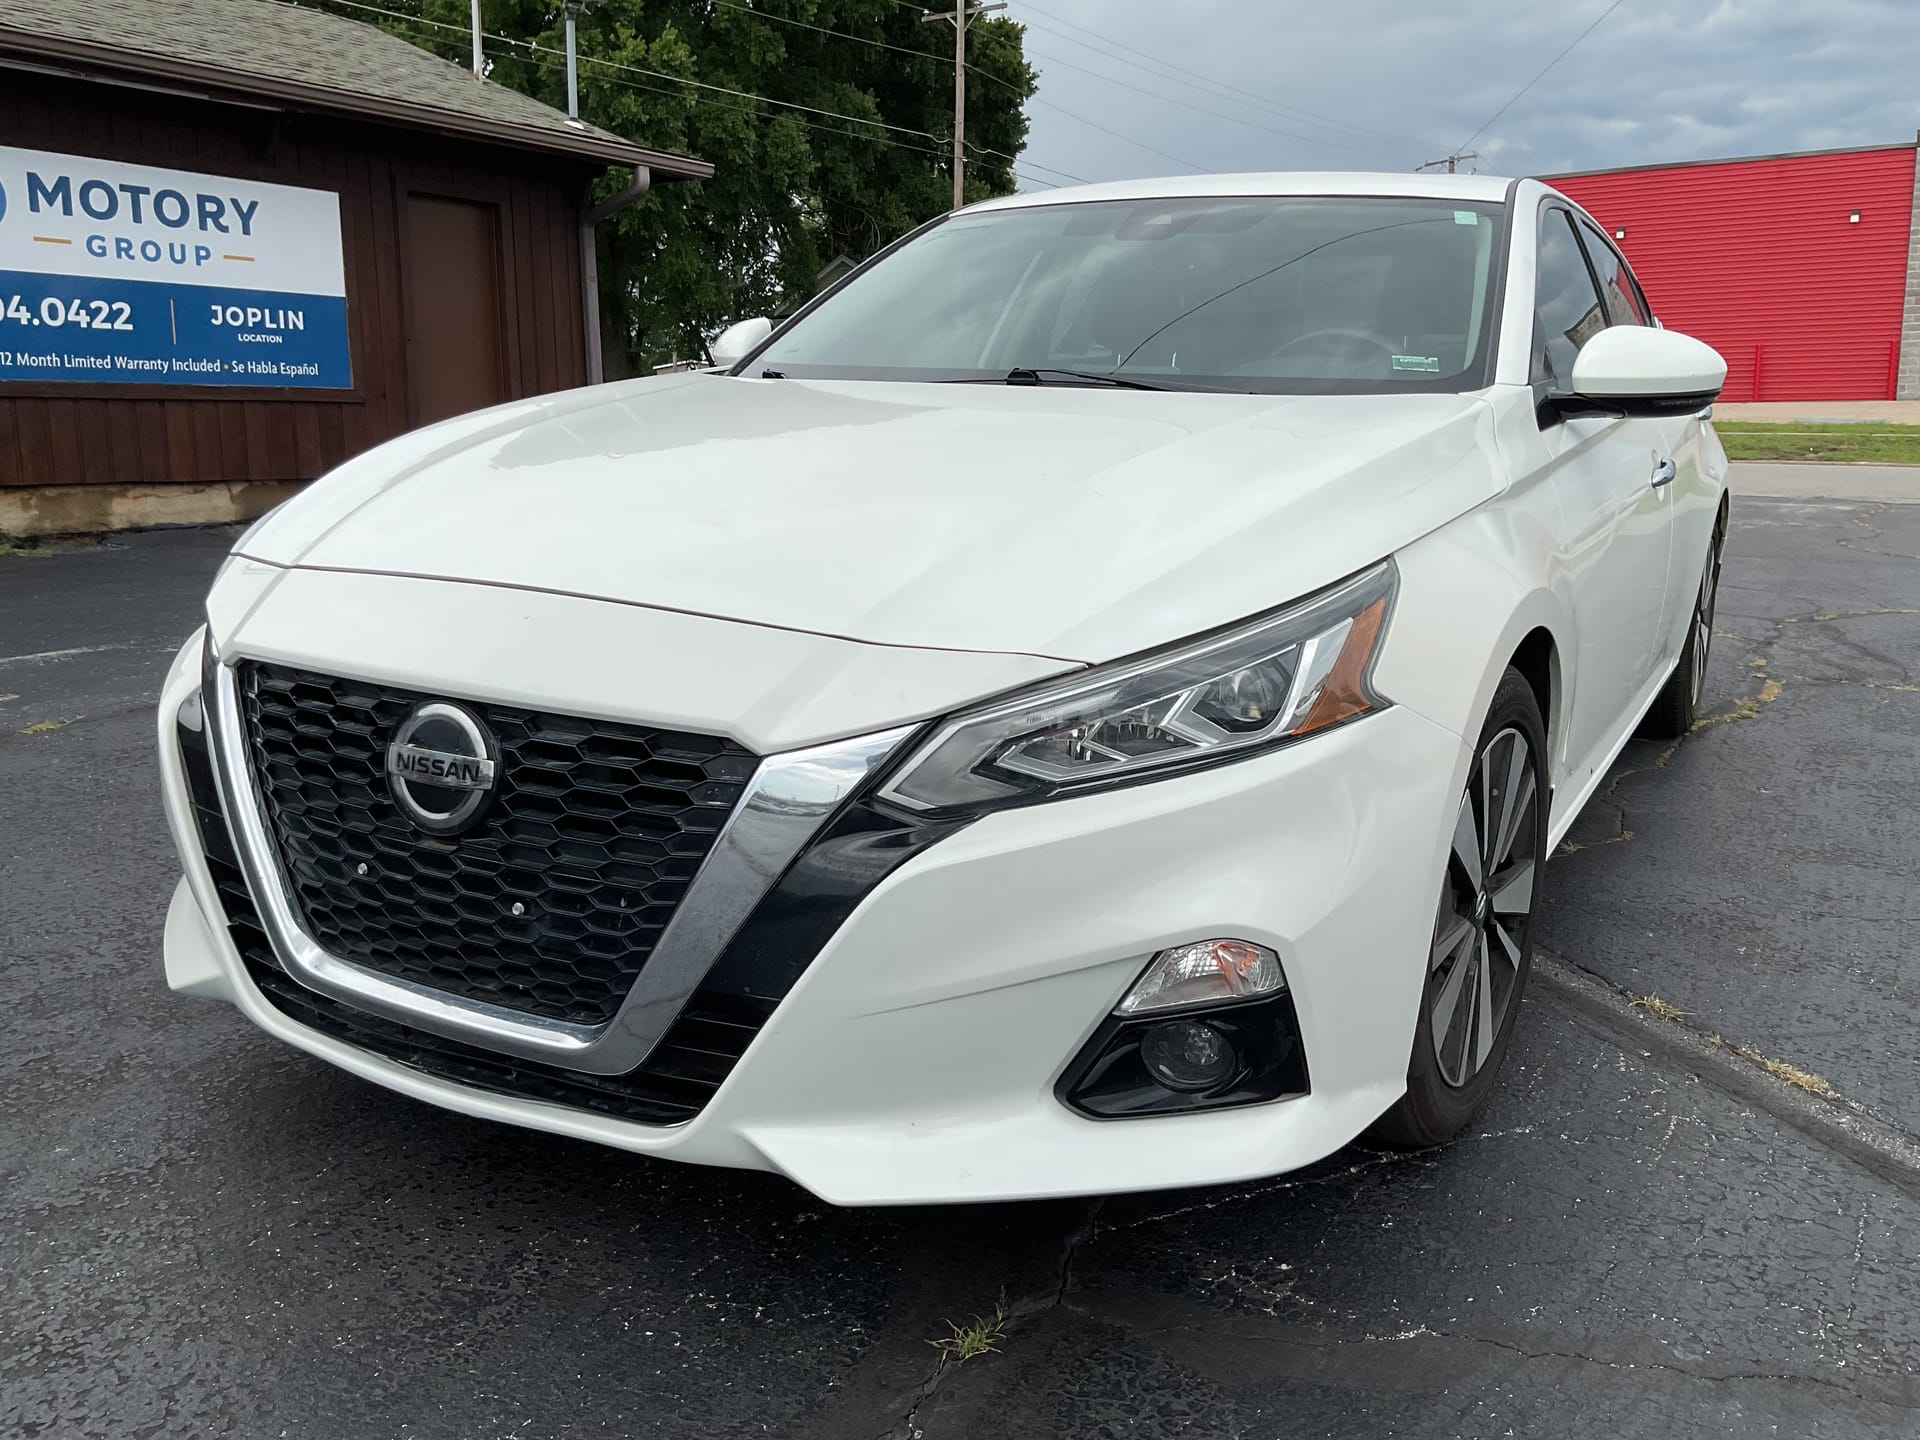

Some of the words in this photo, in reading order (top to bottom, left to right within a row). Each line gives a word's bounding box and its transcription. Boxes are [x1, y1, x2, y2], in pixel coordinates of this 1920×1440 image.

[26, 171, 259, 236] MOTORY
[86, 235, 212, 266] GROUP
[0, 295, 134, 331] 4.0422
[210, 305, 305, 330] JOPLIN
[238, 333, 283, 344] LOCATION
[0, 351, 13, 366] 12
[16, 352, 61, 368] Month
[64, 354, 111, 369] Limited
[114, 356, 169, 374] Warranty
[172, 357, 221, 372] Included
[231, 360, 245, 373] Se
[247, 361, 278, 374] Habla
[280, 362, 319, 378] Español
[397, 752, 480, 782] NISSAN
